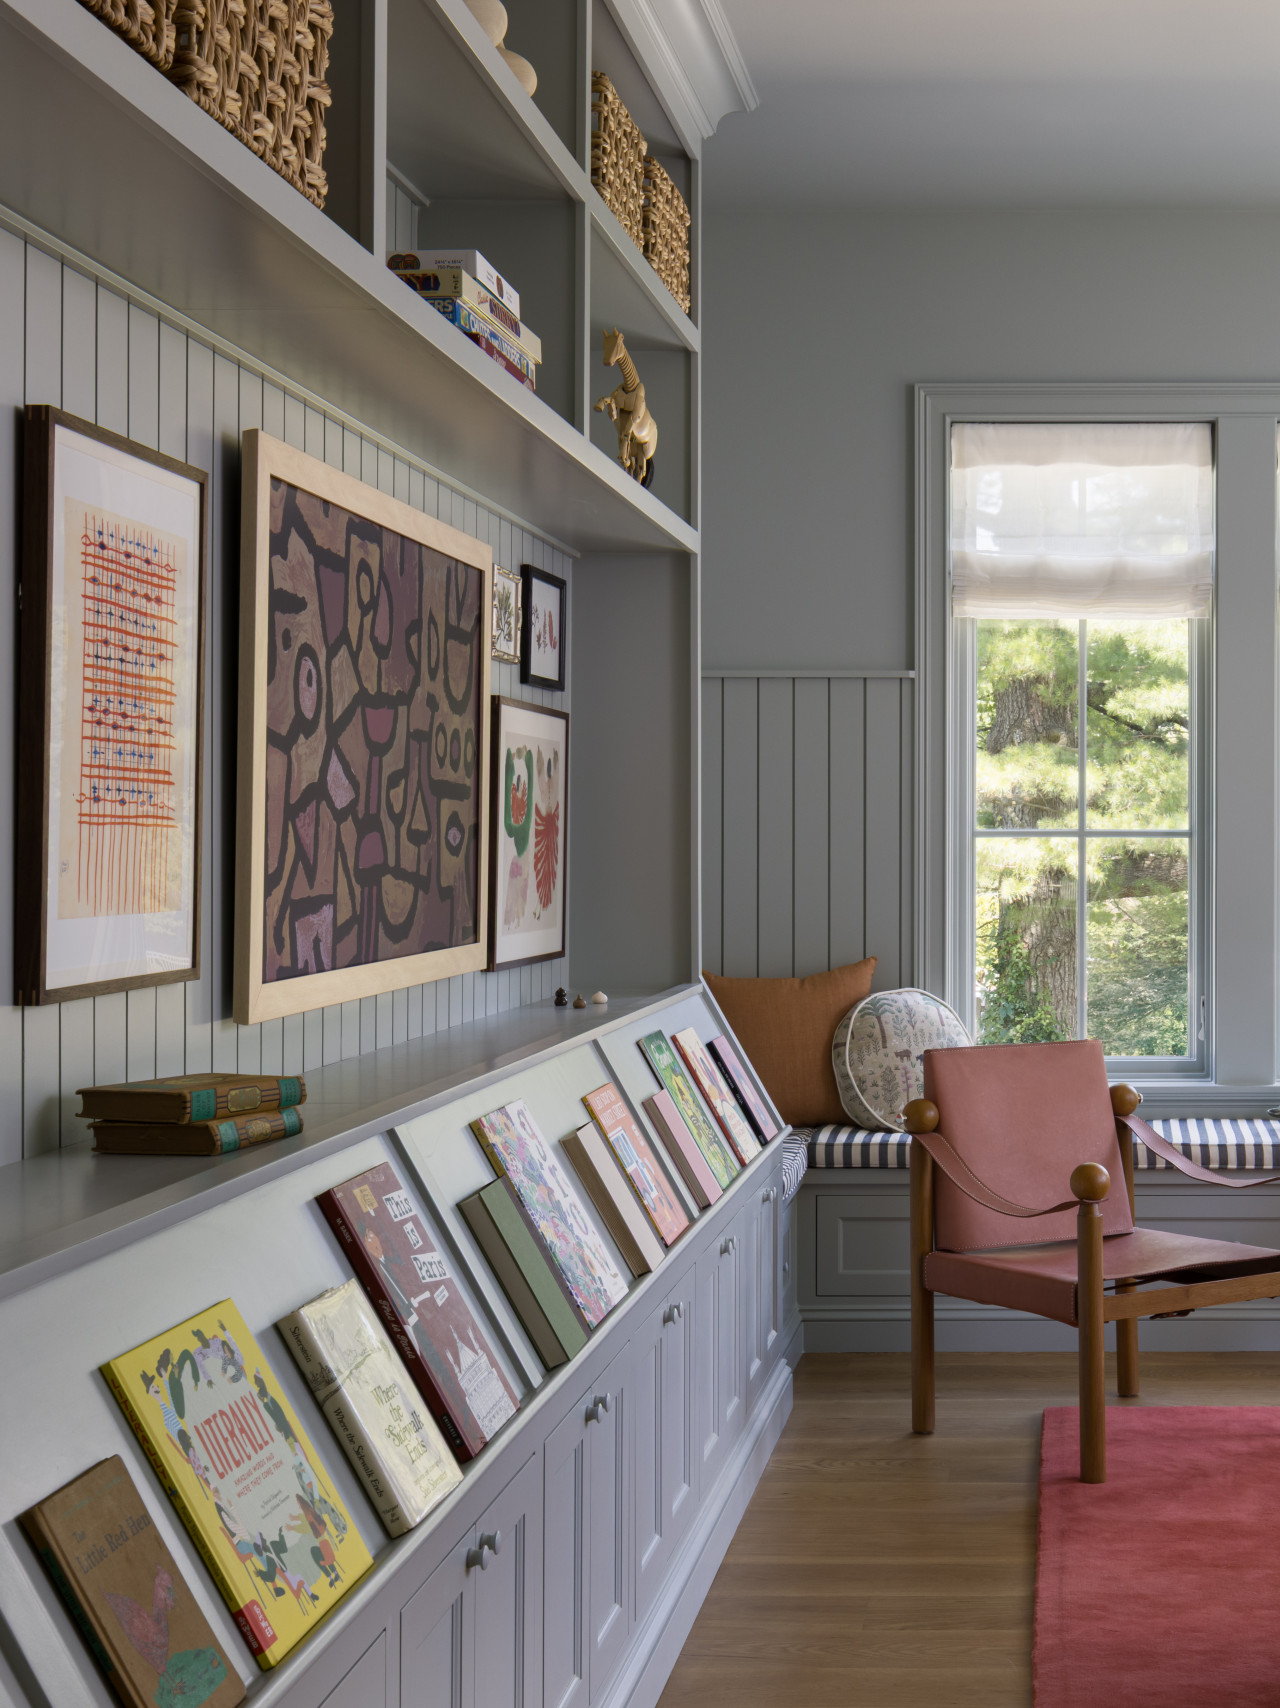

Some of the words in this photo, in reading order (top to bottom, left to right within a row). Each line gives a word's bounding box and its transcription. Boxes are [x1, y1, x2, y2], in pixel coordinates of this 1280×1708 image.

[384, 1194, 413, 1220] This
[404, 1226, 420, 1249] is
[412, 1255, 447, 1281] Paris
[289, 1326, 312, 1364] Silverstein
[378, 1299, 395, 1321] This
[398, 1333, 416, 1359] Paris
[370, 1383, 399, 1409] Where
[389, 1402, 404, 1425] the
[110, 1377, 168, 1481] LITERALLY
[194, 1390, 275, 1480] LITERALLY
[384, 1410, 425, 1448] Sidewalk
[333, 1407, 349, 1433] Where
[346, 1431, 356, 1447] the
[352, 1444, 374, 1480] Sidewalk
[370, 1475, 384, 1499] Ends
[404, 1441, 428, 1465] Ends
[76, 1544, 108, 1575] Little
[104, 1524, 129, 1553] Red
[126, 1513, 152, 1537] Hen
